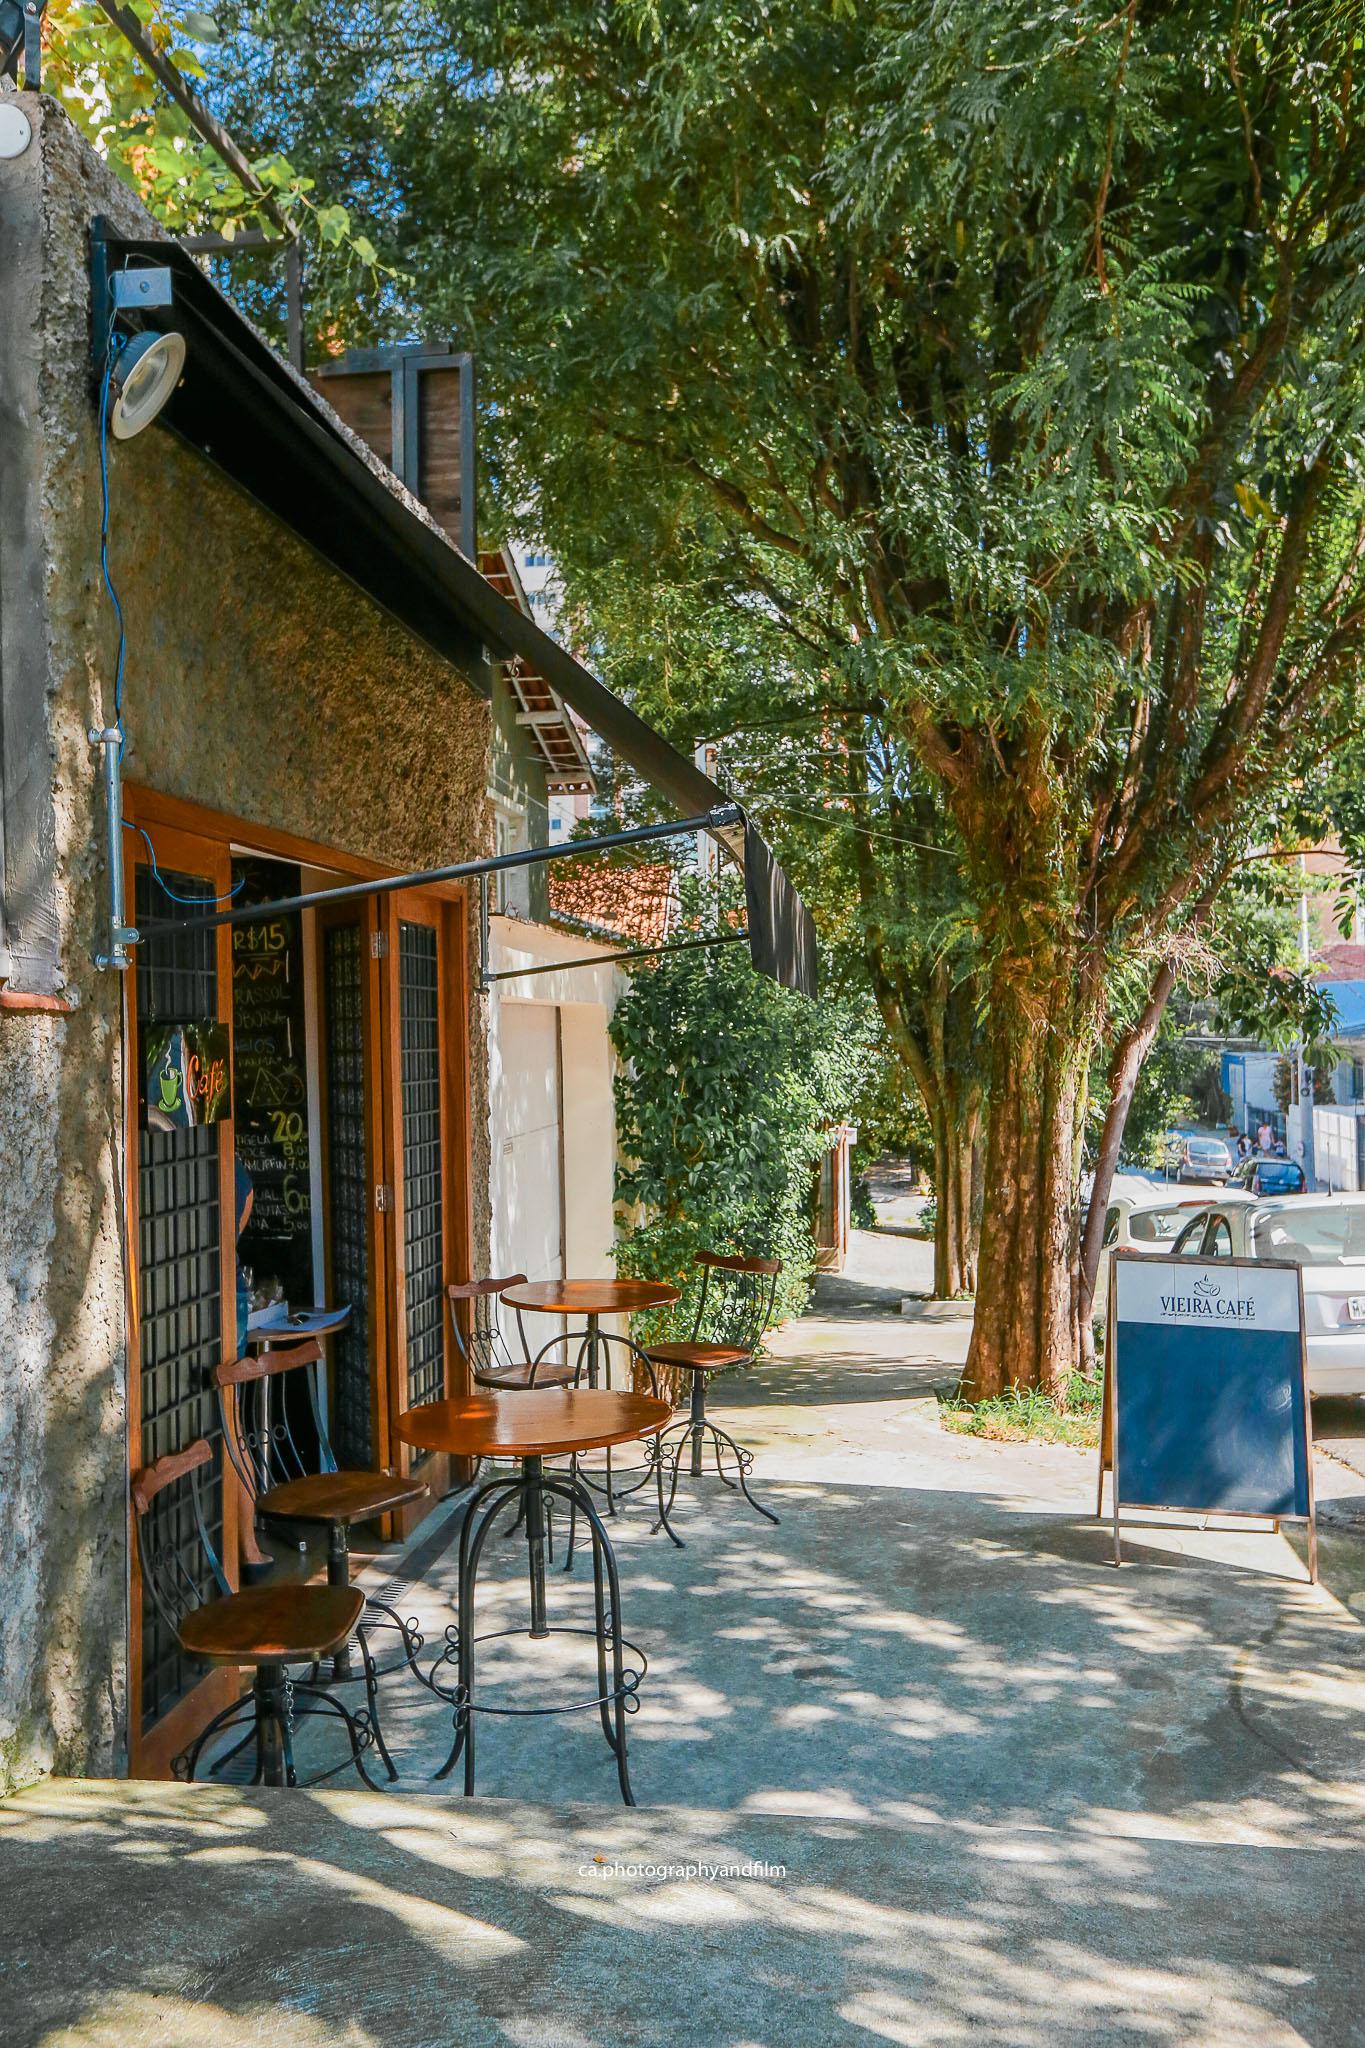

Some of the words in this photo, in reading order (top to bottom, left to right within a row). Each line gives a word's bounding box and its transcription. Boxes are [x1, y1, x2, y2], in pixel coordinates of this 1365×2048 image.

[233, 923, 286, 952] R$15
[187, 1055, 224, 1103] Café
[1160, 1296, 1212, 1314] VIEIRA
[1216, 1297, 1256, 1317] CAFÉ
